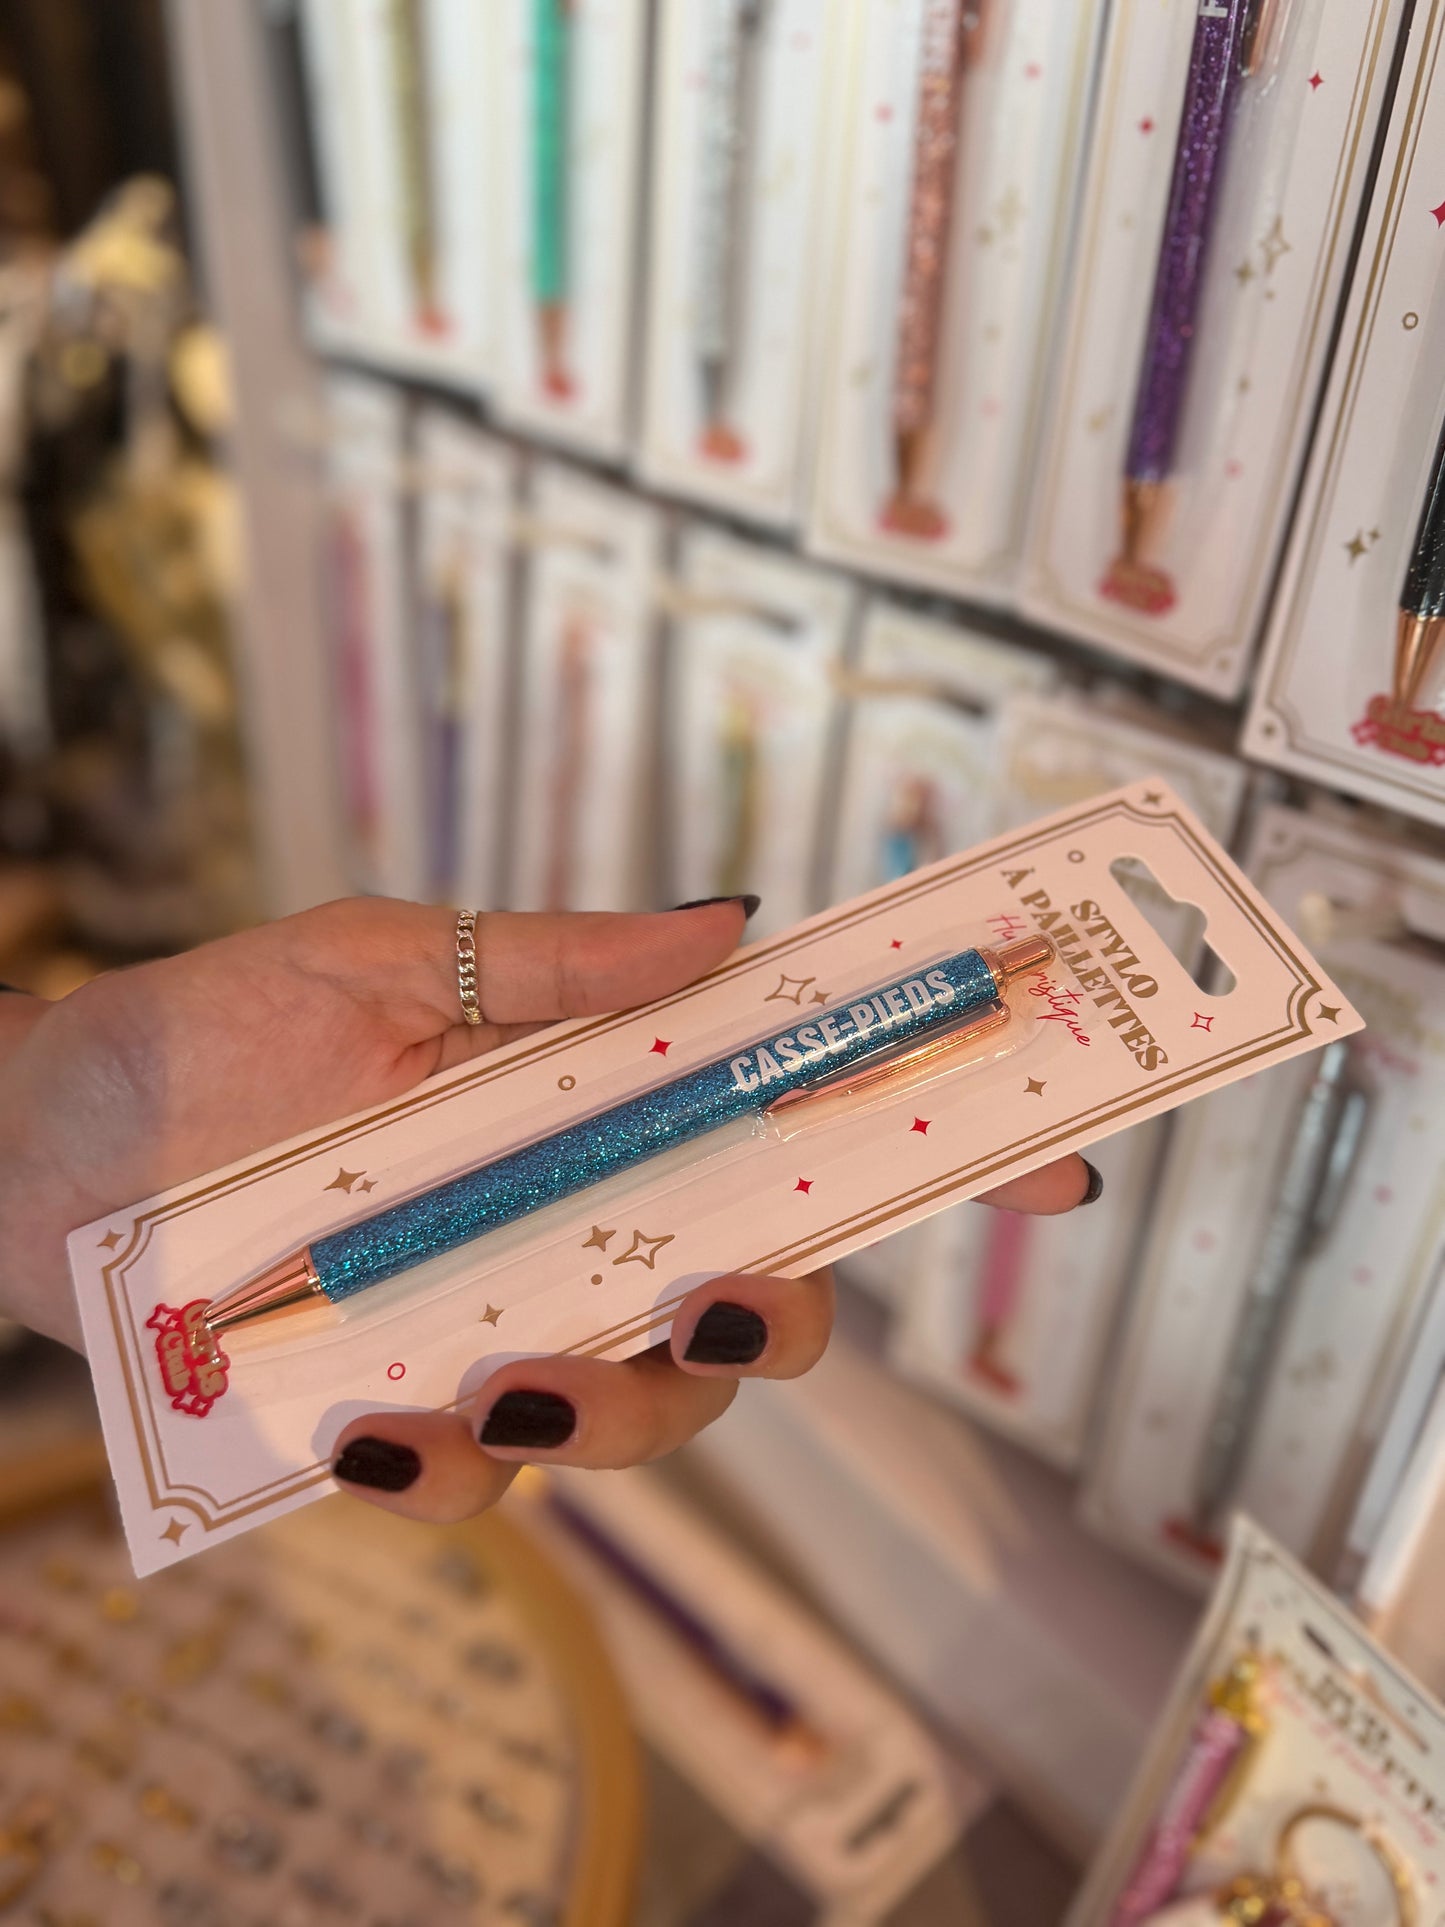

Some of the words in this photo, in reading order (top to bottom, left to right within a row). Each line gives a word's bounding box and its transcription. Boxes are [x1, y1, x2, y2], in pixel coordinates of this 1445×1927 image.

[986, 913, 1091, 1047] Huristique
[1020, 889, 1169, 1072] PAILLETTES
[1070, 899, 1159, 998] STYLO
[730, 970, 955, 1092] CASSE-PIEDS
